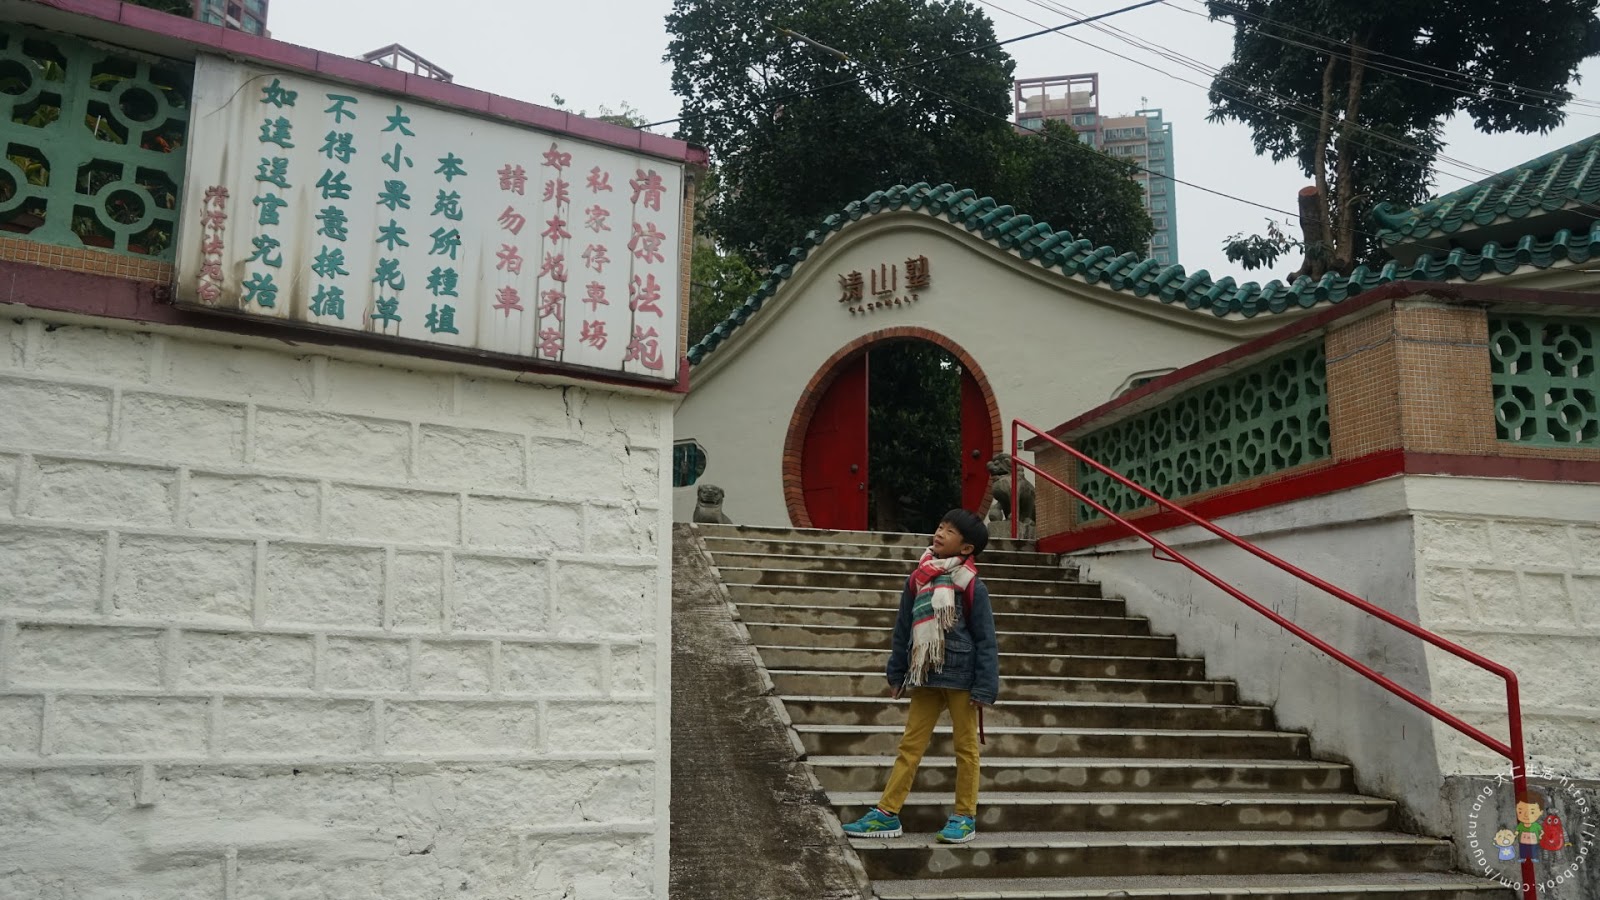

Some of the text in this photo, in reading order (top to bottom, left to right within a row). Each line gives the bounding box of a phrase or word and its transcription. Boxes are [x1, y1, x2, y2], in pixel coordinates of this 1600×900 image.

[308, 93, 359, 321] 不得任意採摘
[371, 104, 416, 329] 大小果木花草
[424, 152, 468, 335] 本苑所種植
[493, 164, 528, 318] 請勿泊車
